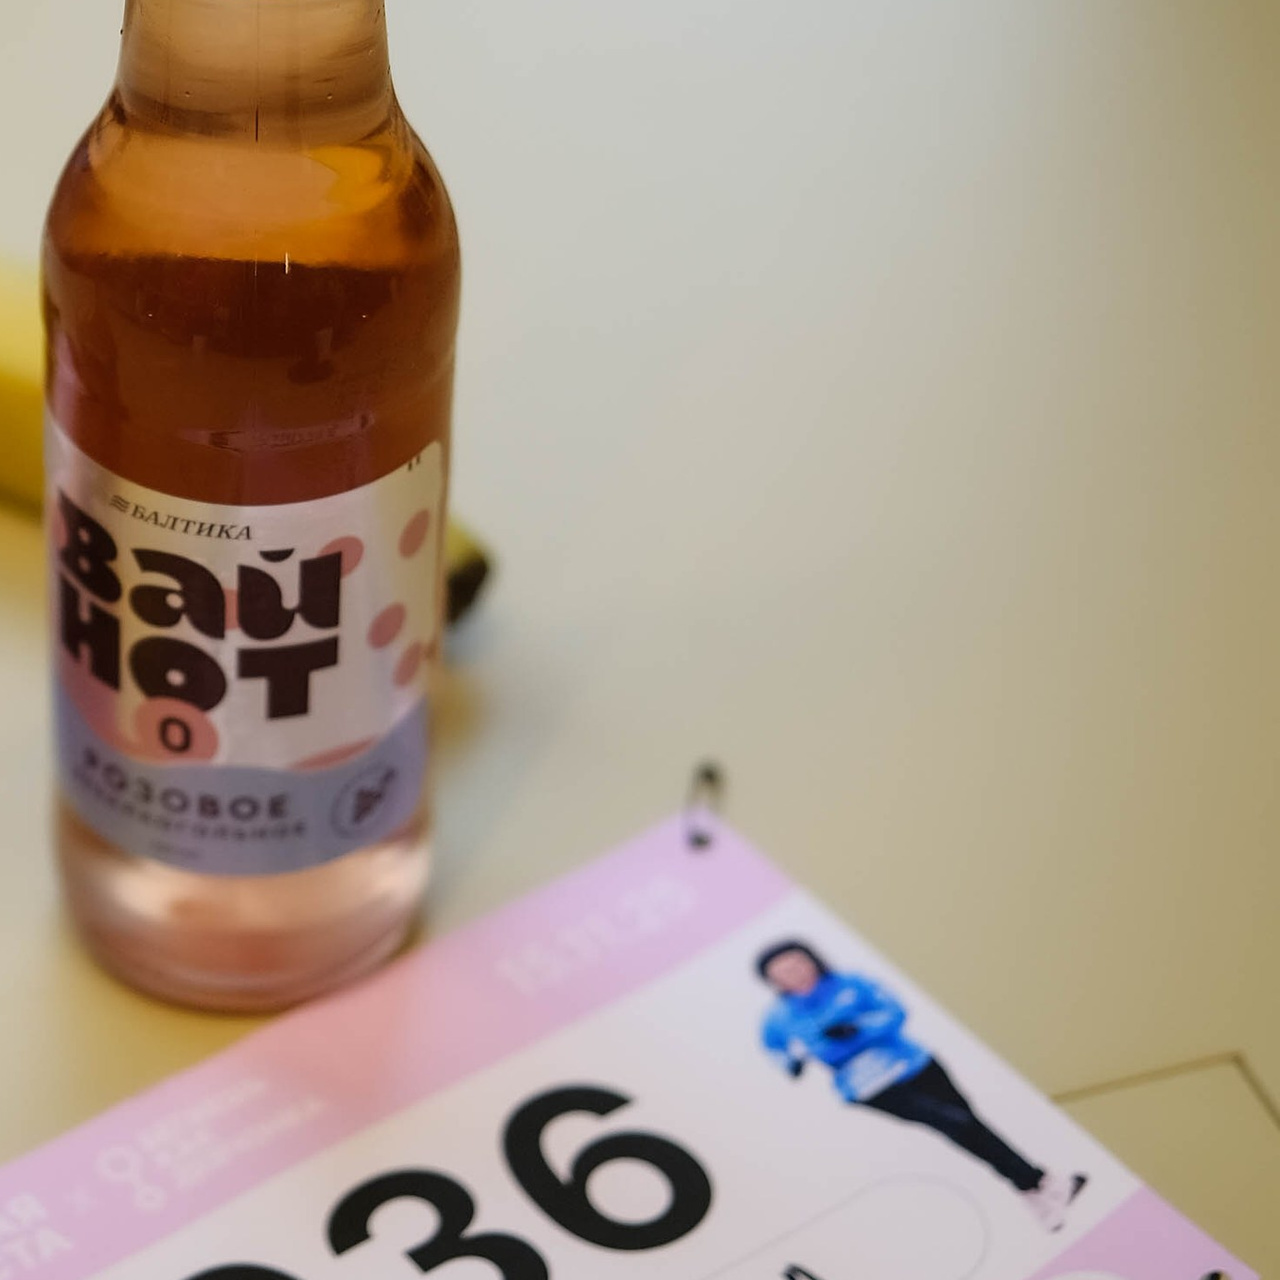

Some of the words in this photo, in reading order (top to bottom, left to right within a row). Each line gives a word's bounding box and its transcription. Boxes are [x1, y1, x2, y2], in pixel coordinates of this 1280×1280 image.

[131, 504, 254, 542] БАЛТИКА
[158, 716, 193, 754] 0
[82, 746, 292, 822] РОЗОВОЕ
